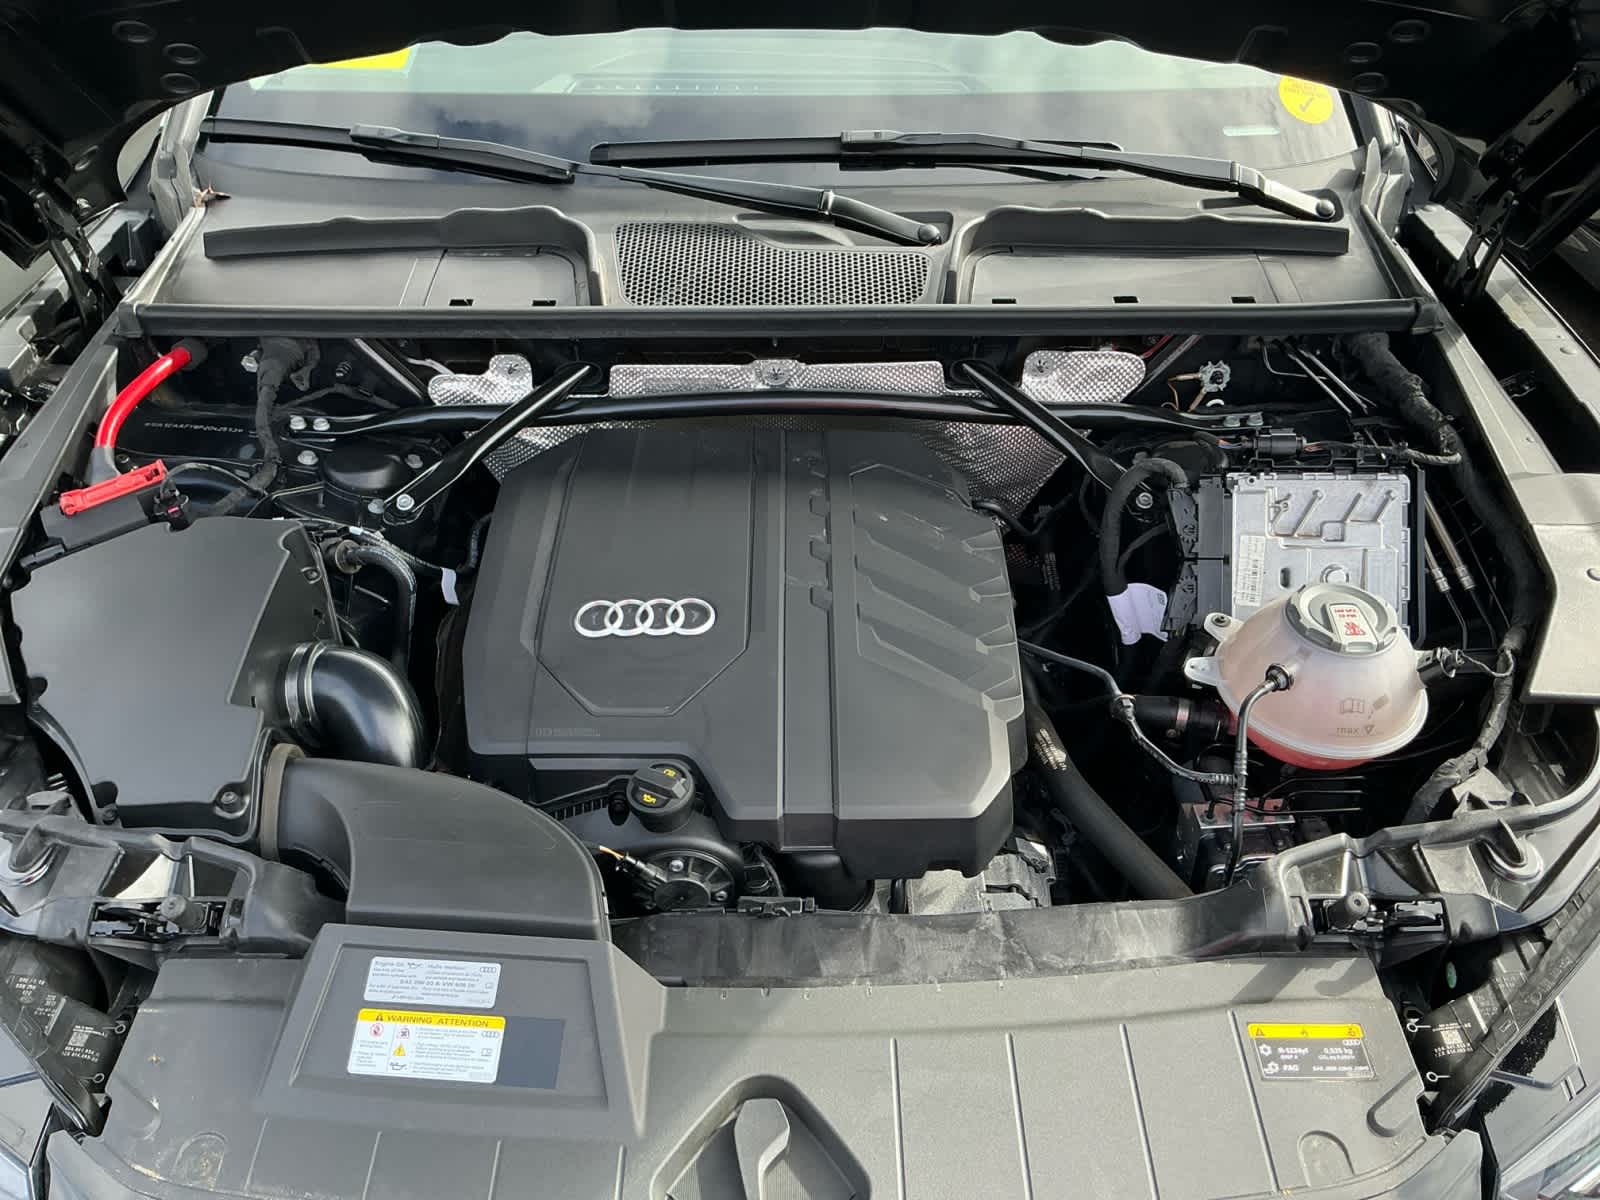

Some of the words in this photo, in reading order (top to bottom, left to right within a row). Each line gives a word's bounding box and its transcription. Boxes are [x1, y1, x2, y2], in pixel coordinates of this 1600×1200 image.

[1336, 727, 1360, 736] max
[388, 1014, 432, 1025] WARNING
[438, 1016, 488, 1028] ATTENTION
